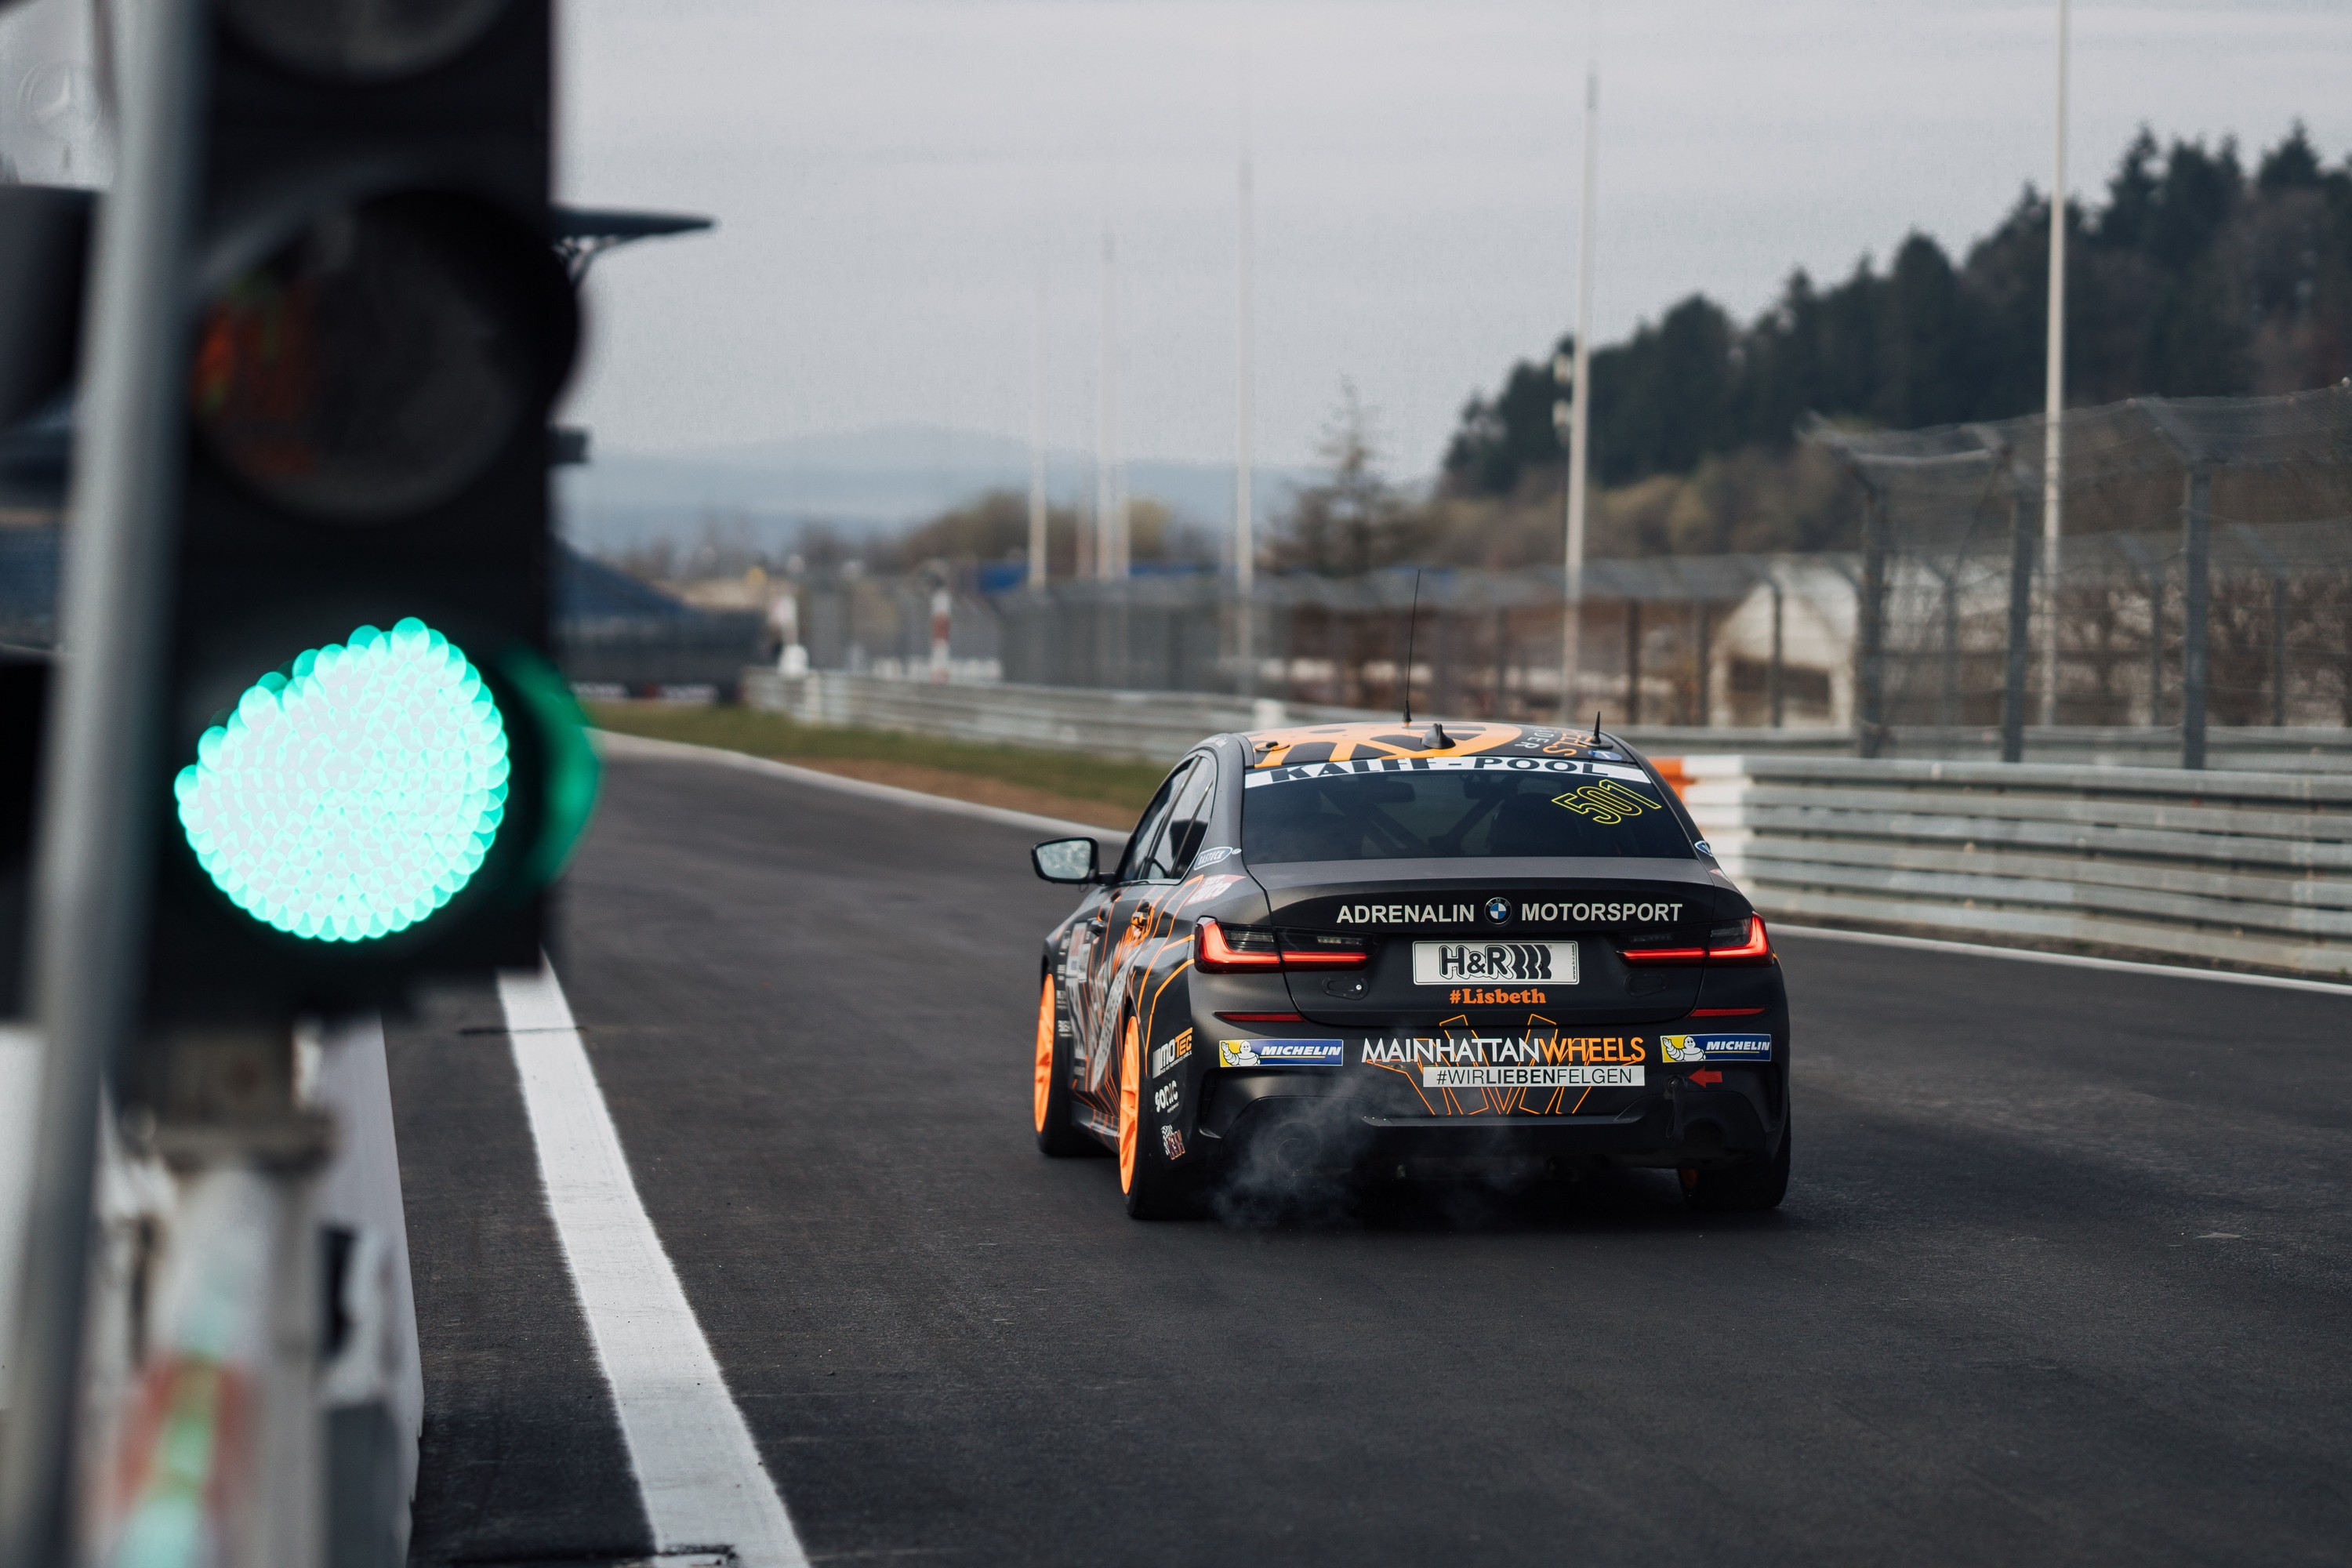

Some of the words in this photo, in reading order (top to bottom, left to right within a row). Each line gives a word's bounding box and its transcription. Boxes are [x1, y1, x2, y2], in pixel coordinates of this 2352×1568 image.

[1552, 779, 1662, 824] 501
[1337, 905, 1475, 924] ADRENALIN
[1521, 903, 1682, 921] MOTORSPORT
[1439, 945, 1513, 979] H&R
[1450, 988, 1547, 1004] #Lisbeth
[1261, 1046, 1341, 1056] MICHELIN
[1706, 1041, 1770, 1051] MICHELIN
[1436, 1069, 1632, 1084] #WIRLIEBENFELGEN
